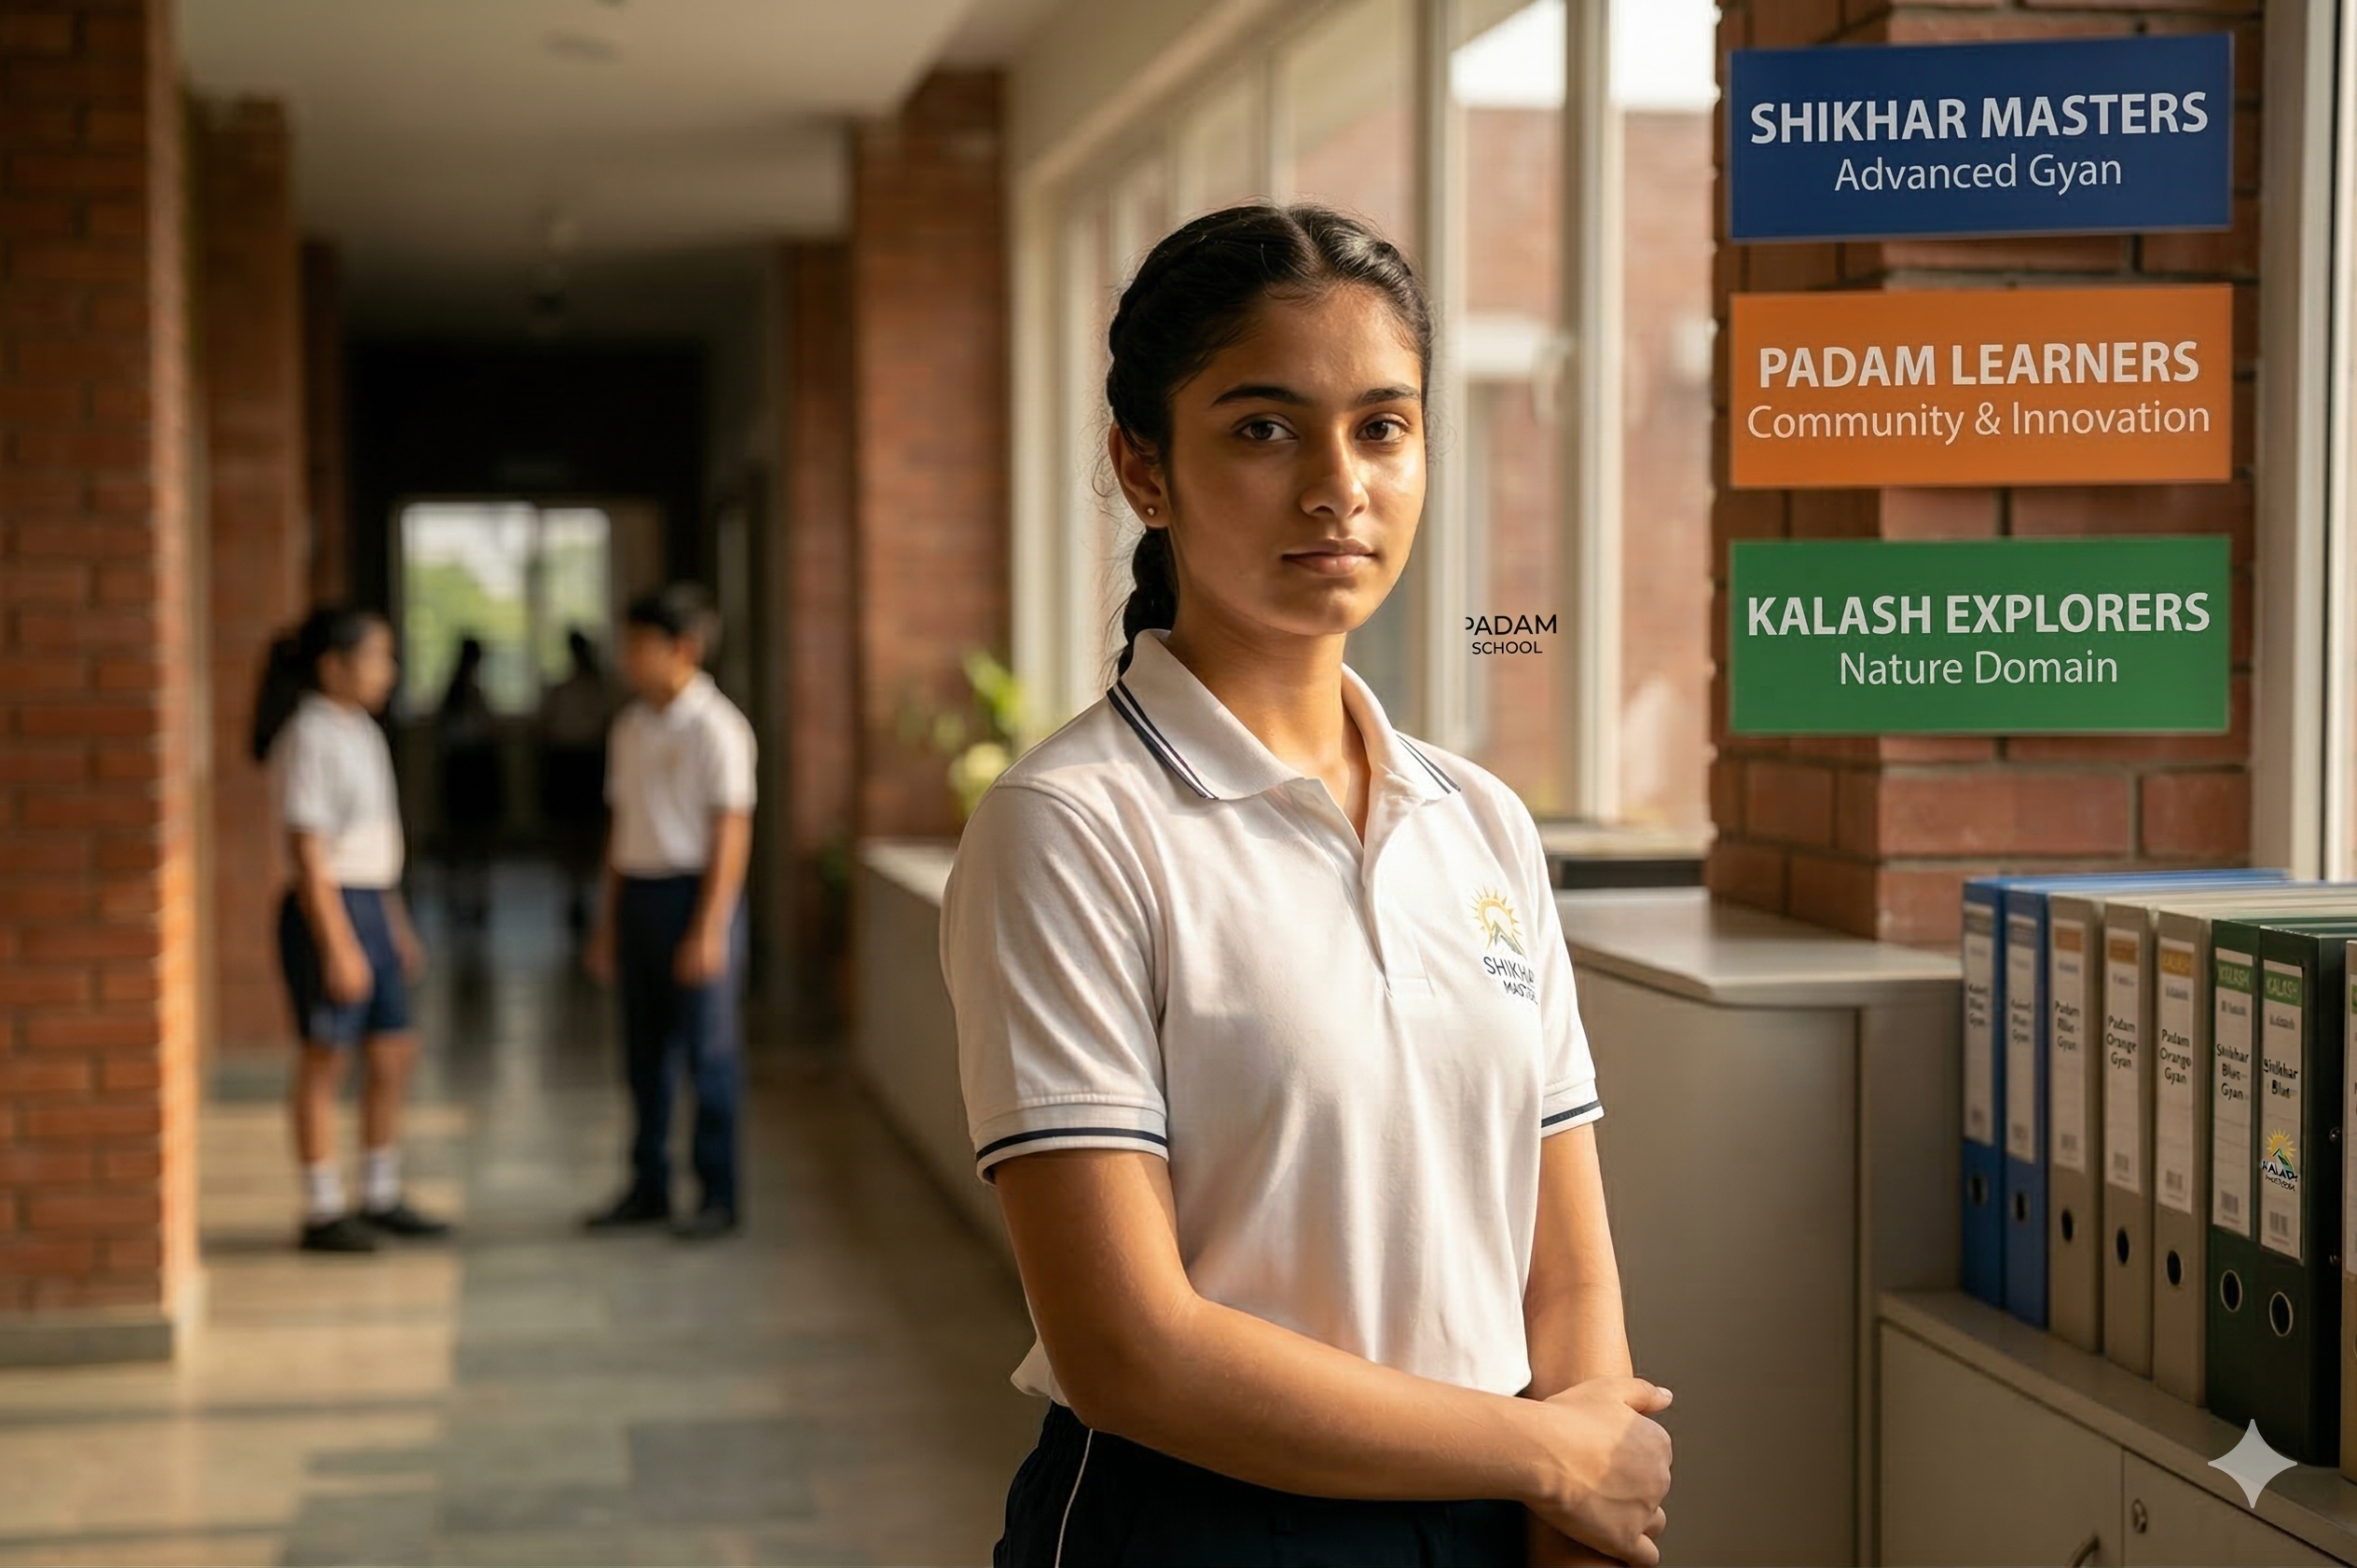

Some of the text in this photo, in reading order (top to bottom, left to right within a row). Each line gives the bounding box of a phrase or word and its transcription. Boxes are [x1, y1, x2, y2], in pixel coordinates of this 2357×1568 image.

[1750, 91, 2209, 144] SHIKHAR MASTERS
[1834, 153, 2122, 196] Advanced Gyan
[1759, 340, 2199, 388] PADAM LEARNERS
[1747, 399, 2210, 446] Community & Innovation
[1748, 592, 2210, 636] KALASH EXPLORERS
[1840, 649, 2118, 685] Nature Domain
[2164, 1066, 2187, 1085] Gyan
[2221, 1081, 2244, 1101] Gyan
